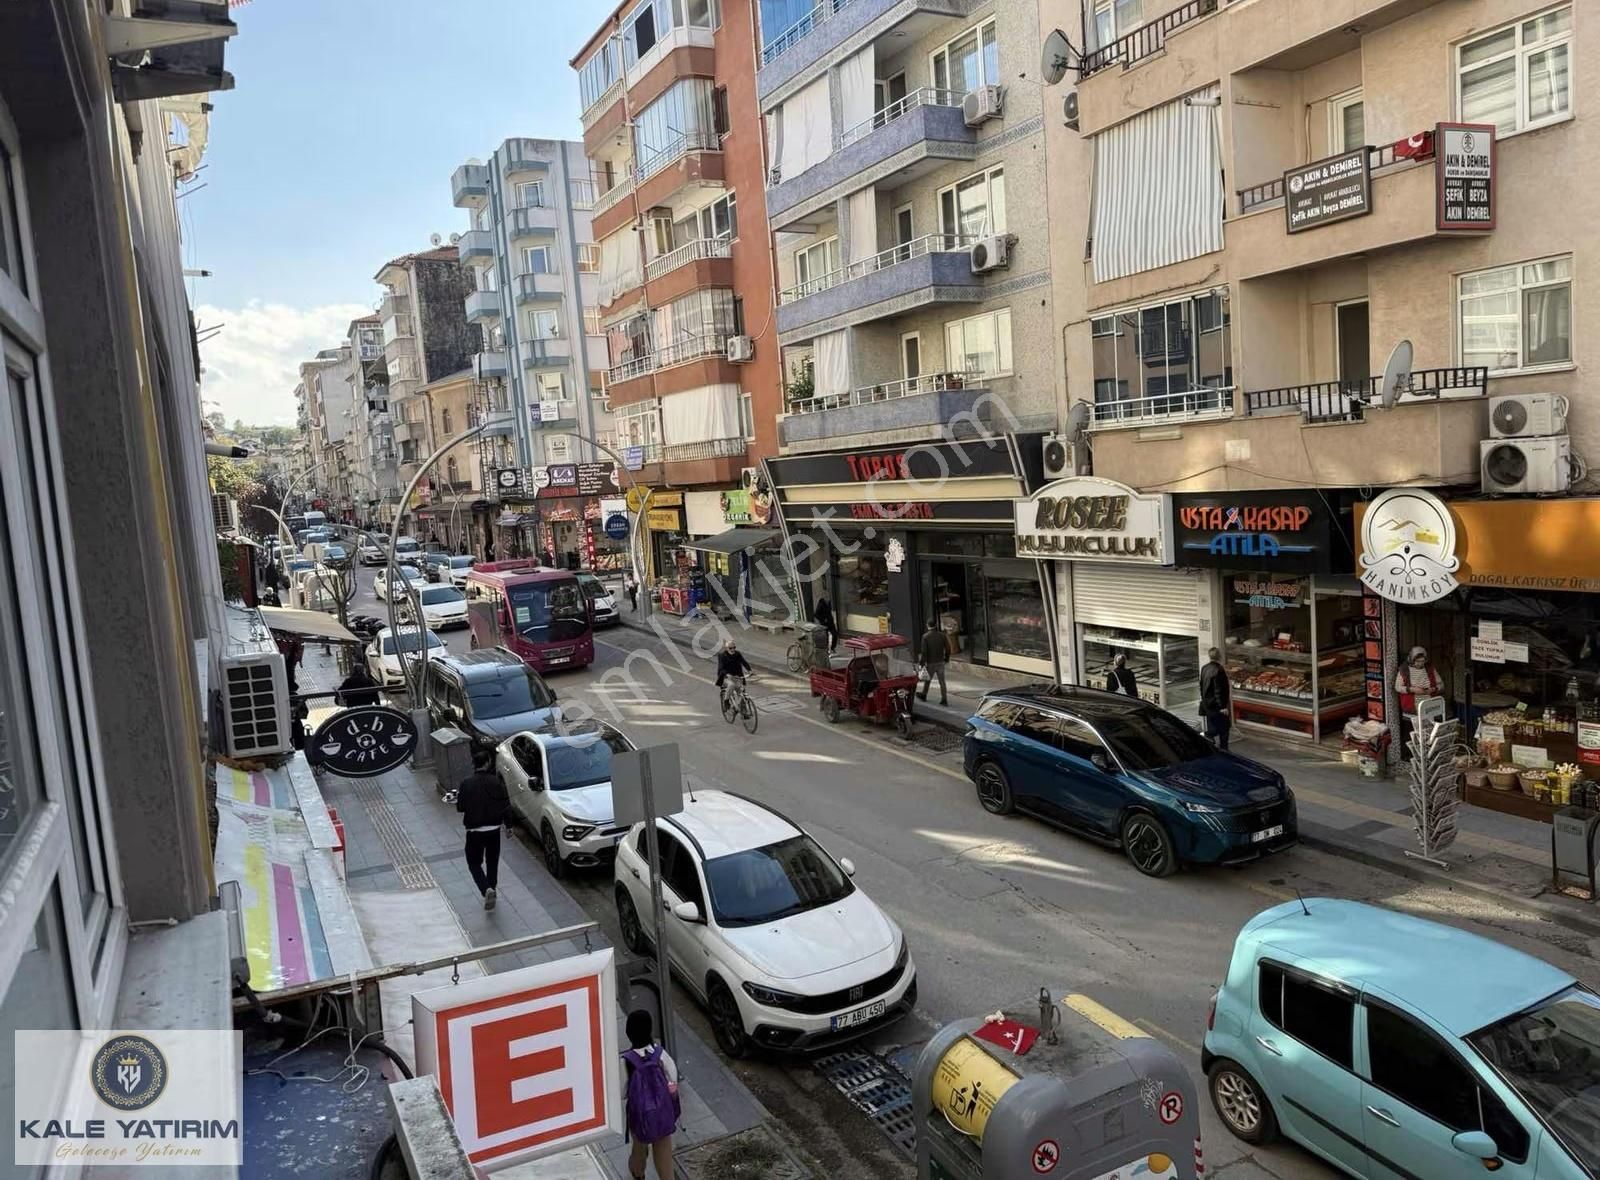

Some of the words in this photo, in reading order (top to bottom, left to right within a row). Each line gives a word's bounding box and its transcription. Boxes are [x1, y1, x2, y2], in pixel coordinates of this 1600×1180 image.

[1304, 169, 1320, 183] AKIN
[1322, 168, 1329, 177] &
[1469, 188, 1488, 202] BEYZA
[1307, 207, 1320, 218] AKIN
[1447, 206, 1462, 219] AKIN
[847, 453, 909, 481] TOROS
[1035, 494, 1130, 531] ROSEE
[1180, 506, 1225, 531] USTA
[1243, 505, 1313, 531] KASAP
[1018, 534, 1158, 557] KUYUMCULUK
[1365, 570, 1453, 600] HANIMKÖY
[1512, 575, 1566, 587] KATKISIZ
[345, 744, 389, 763] CAFE
[838, 1015, 848, 1027] 77
[471, 1004, 574, 1139] E
